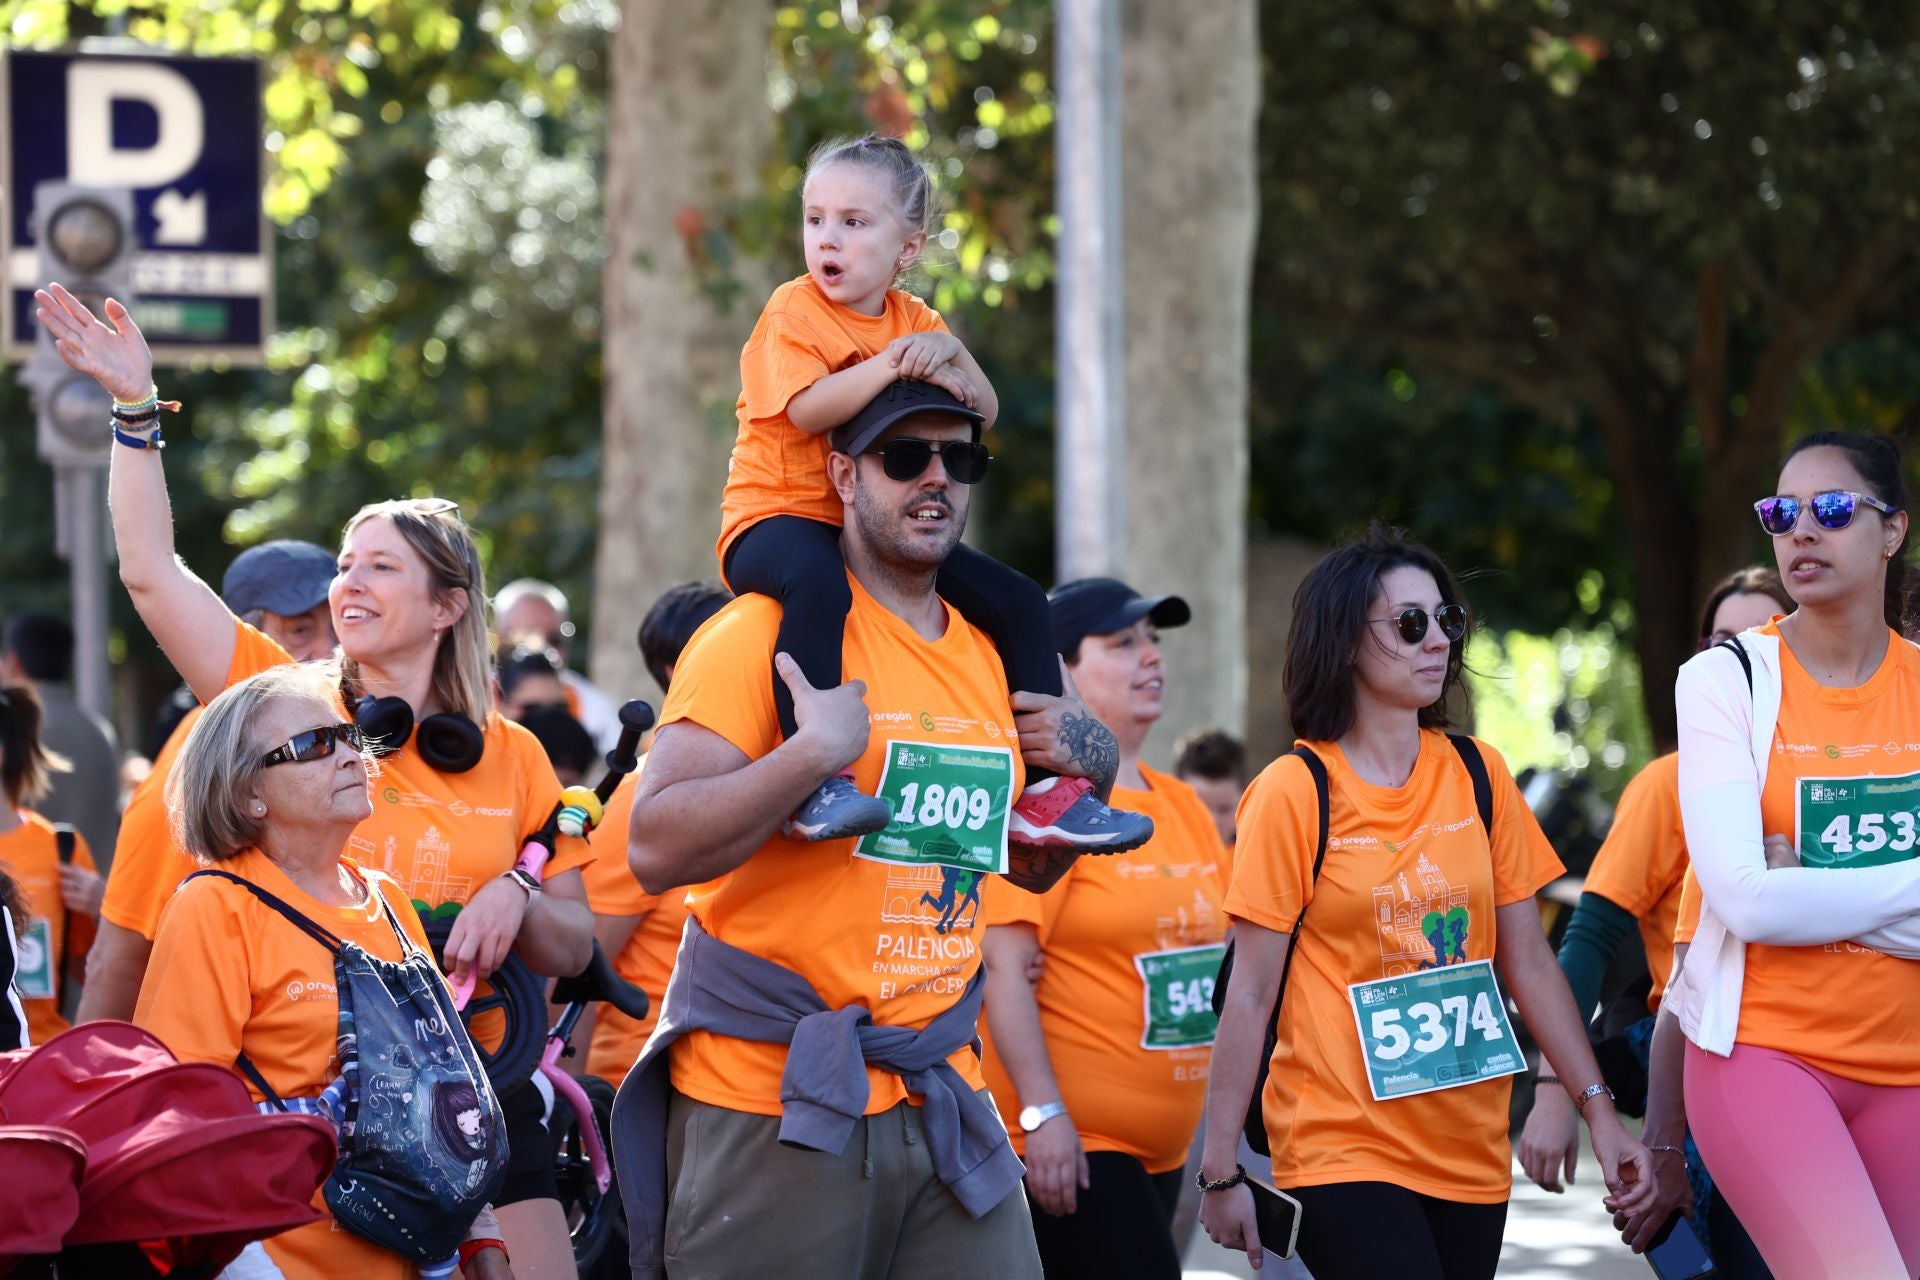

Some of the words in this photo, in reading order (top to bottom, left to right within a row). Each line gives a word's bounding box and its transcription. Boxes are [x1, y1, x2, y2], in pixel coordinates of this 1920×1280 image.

[873, 710, 913, 723] oregón
[475, 807, 512, 817] repsol
[894, 782, 991, 831] 1809
[1444, 815, 1474, 833] repsol
[1821, 811, 1920, 853] 453
[1342, 835, 1378, 846] oregón
[876, 934, 975, 960] PALENCIA
[872, 962, 888, 973] EN
[890, 963, 940, 976] MARCHA
[1371, 991, 1504, 1060] 5374
[1487, 1053, 1512, 1065] contra
[1383, 1072, 1419, 1085] Palencia
